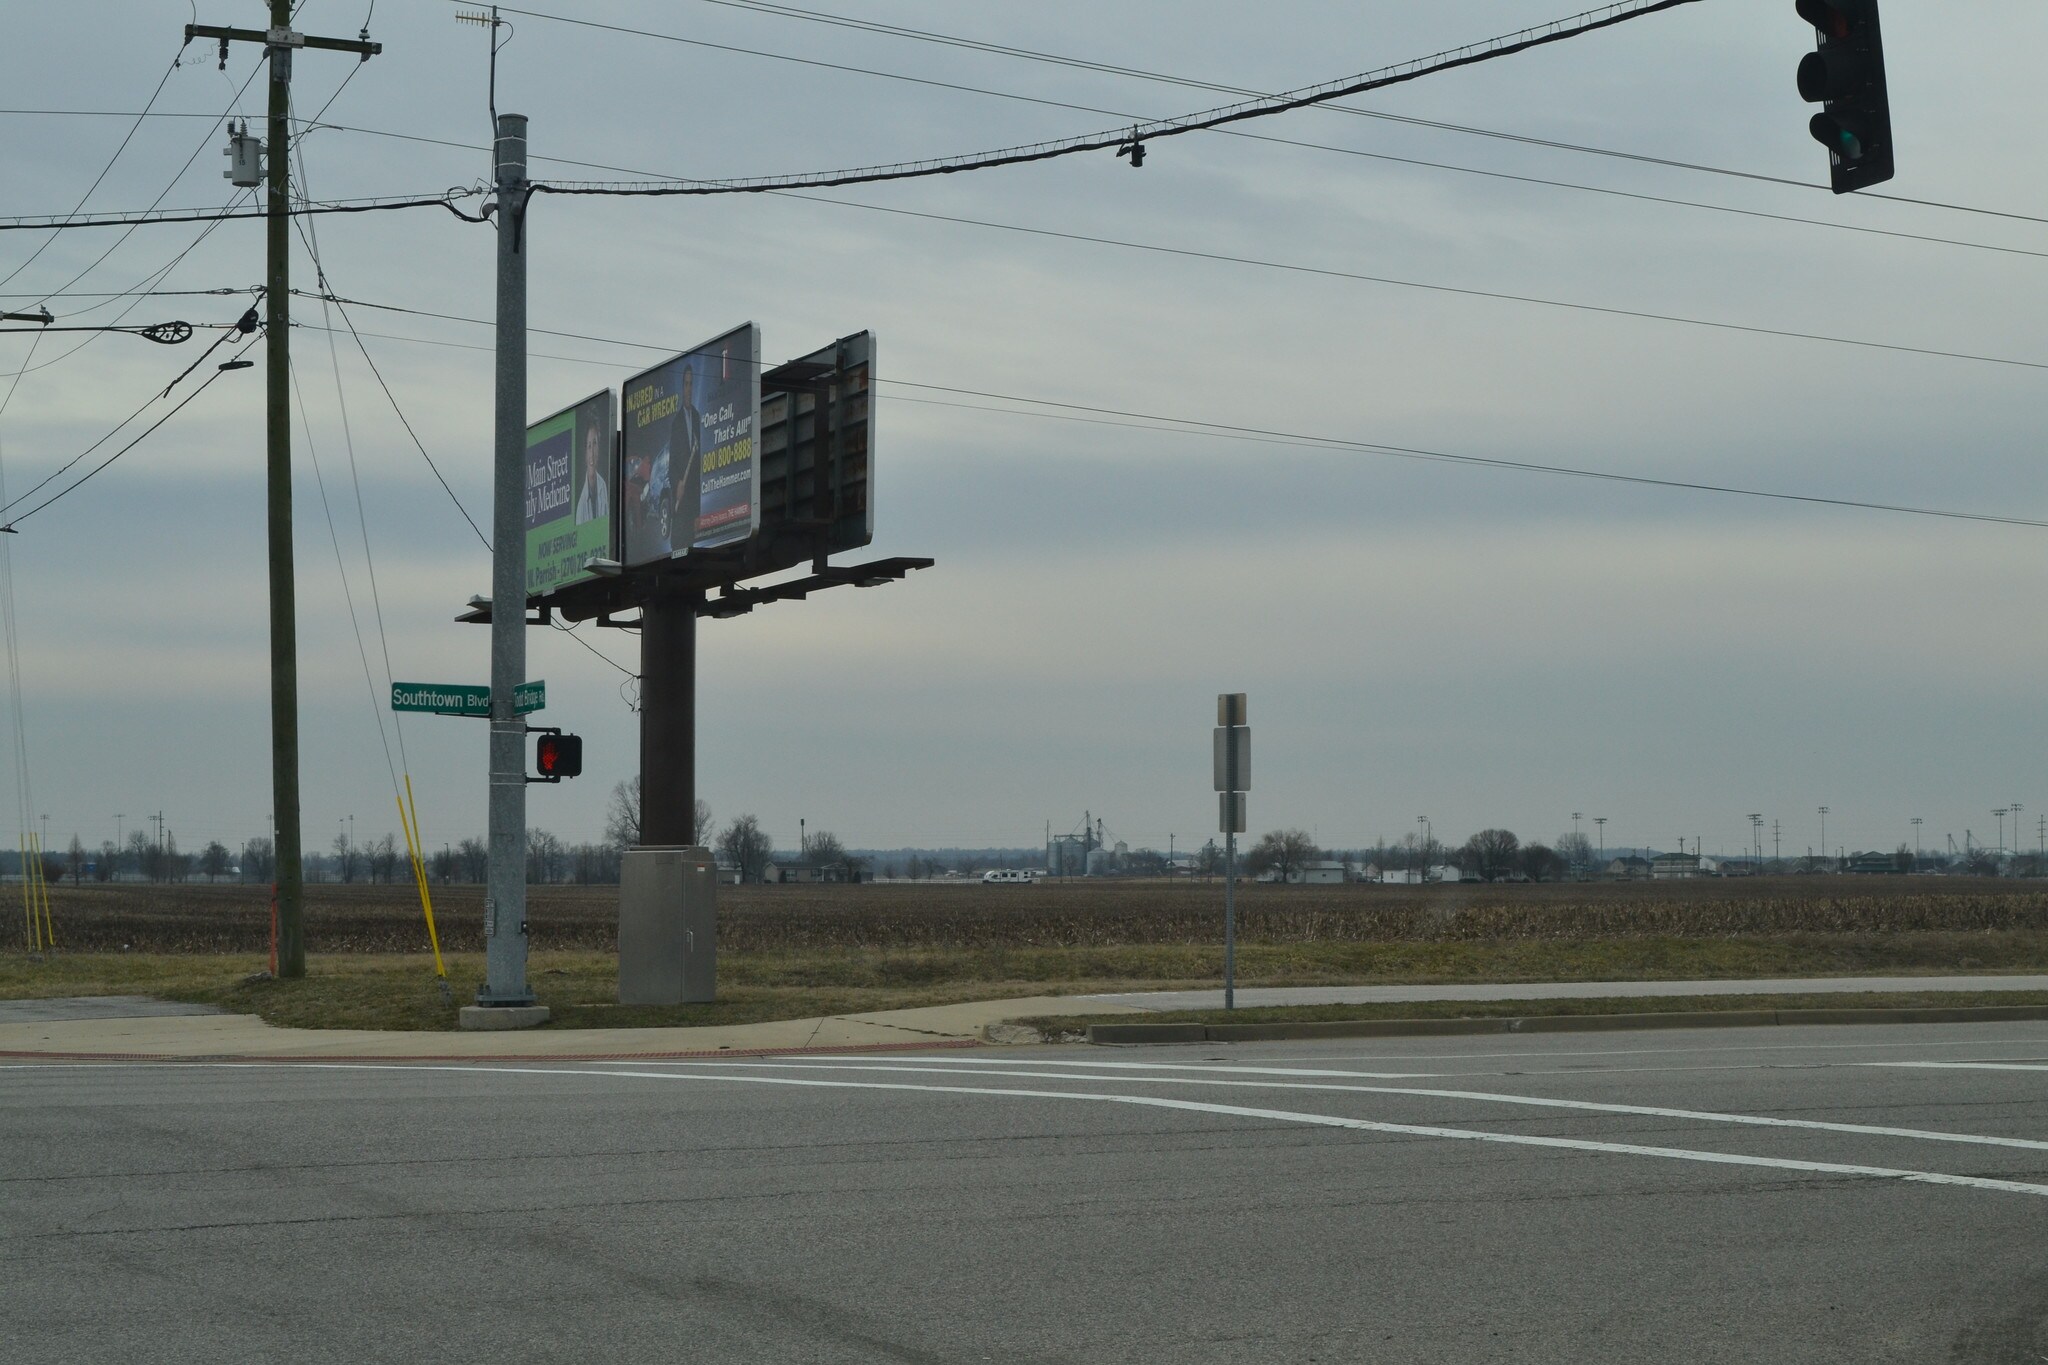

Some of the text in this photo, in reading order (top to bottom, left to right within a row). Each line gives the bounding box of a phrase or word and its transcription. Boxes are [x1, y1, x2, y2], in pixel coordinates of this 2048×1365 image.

[626, 384, 653, 413] INJURED
[719, 402, 734, 422] Call,
[713, 424, 735, 445] That's
[528, 452, 568, 489] Main Street
[701, 469, 751, 494] CallTheHammer.com
[526, 479, 570, 523] ily Medicine
[538, 541, 551, 560] NOW
[536, 560, 557, 587] Parrish
[561, 554, 577, 582] (270)
[393, 689, 489, 708] Southtown Blvd
